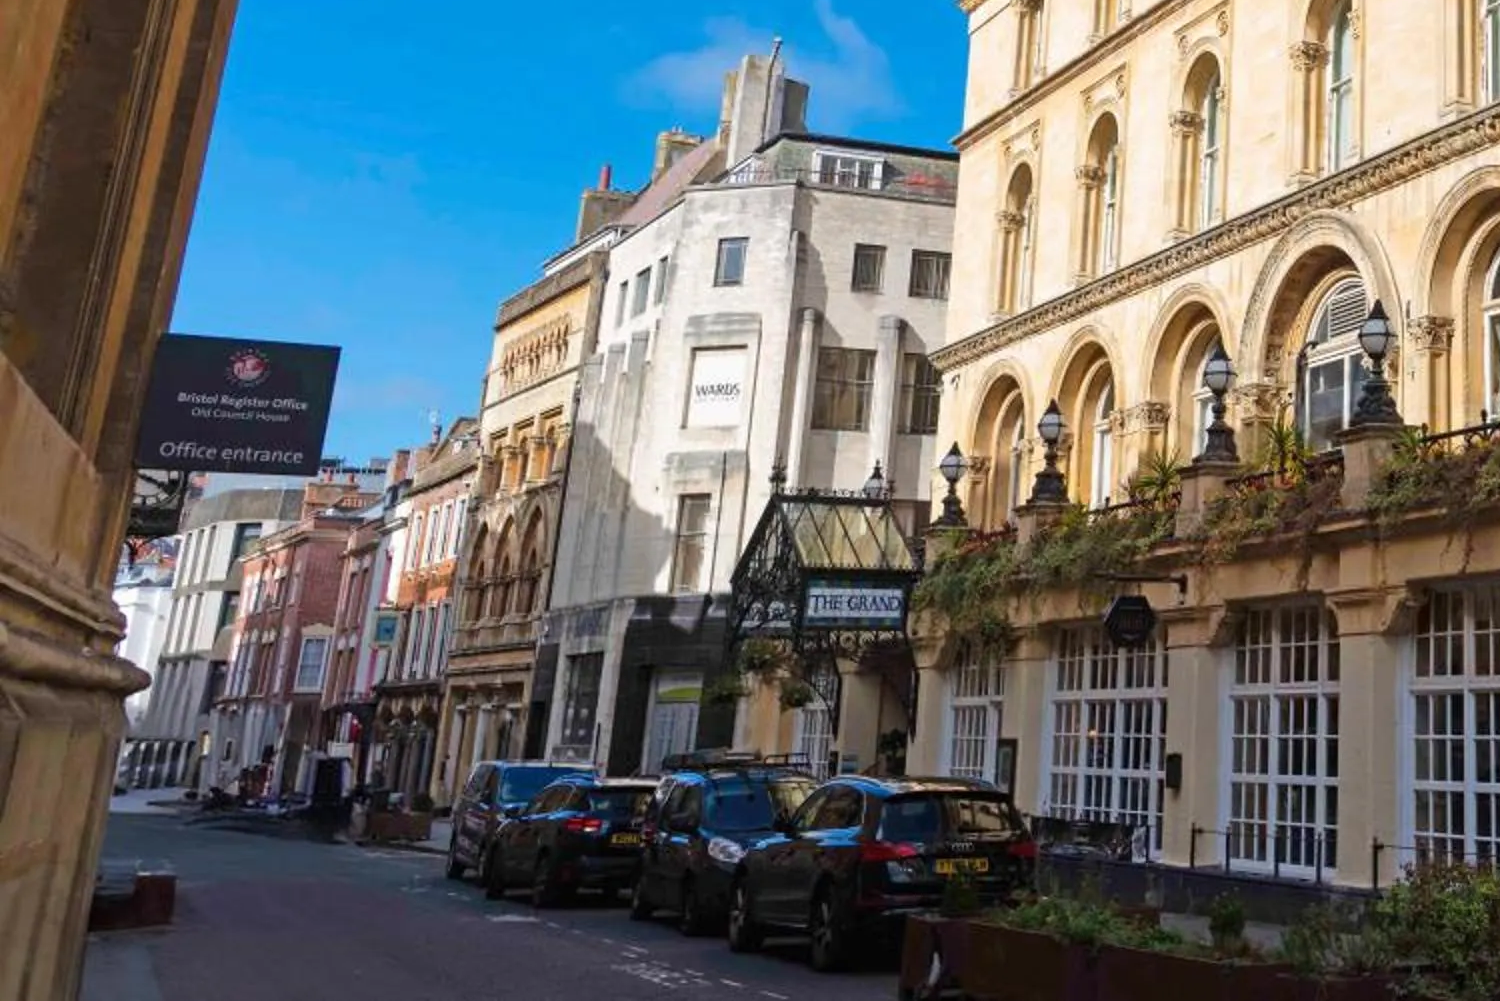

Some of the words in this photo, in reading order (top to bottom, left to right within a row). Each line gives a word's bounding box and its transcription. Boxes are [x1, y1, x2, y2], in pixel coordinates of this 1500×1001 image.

[695, 382, 741, 397] WARDS
[177, 391, 219, 404] Bristol
[220, 394, 270, 409] Register
[271, 398, 308, 410] Office
[191, 407, 212, 418] Old
[213, 408, 255, 420] Council
[256, 411, 291, 422] House
[159, 441, 217, 459] Office
[221, 447, 304, 464] entrance
[809, 594, 842, 613] THE
[847, 593, 901, 612] GRAND
